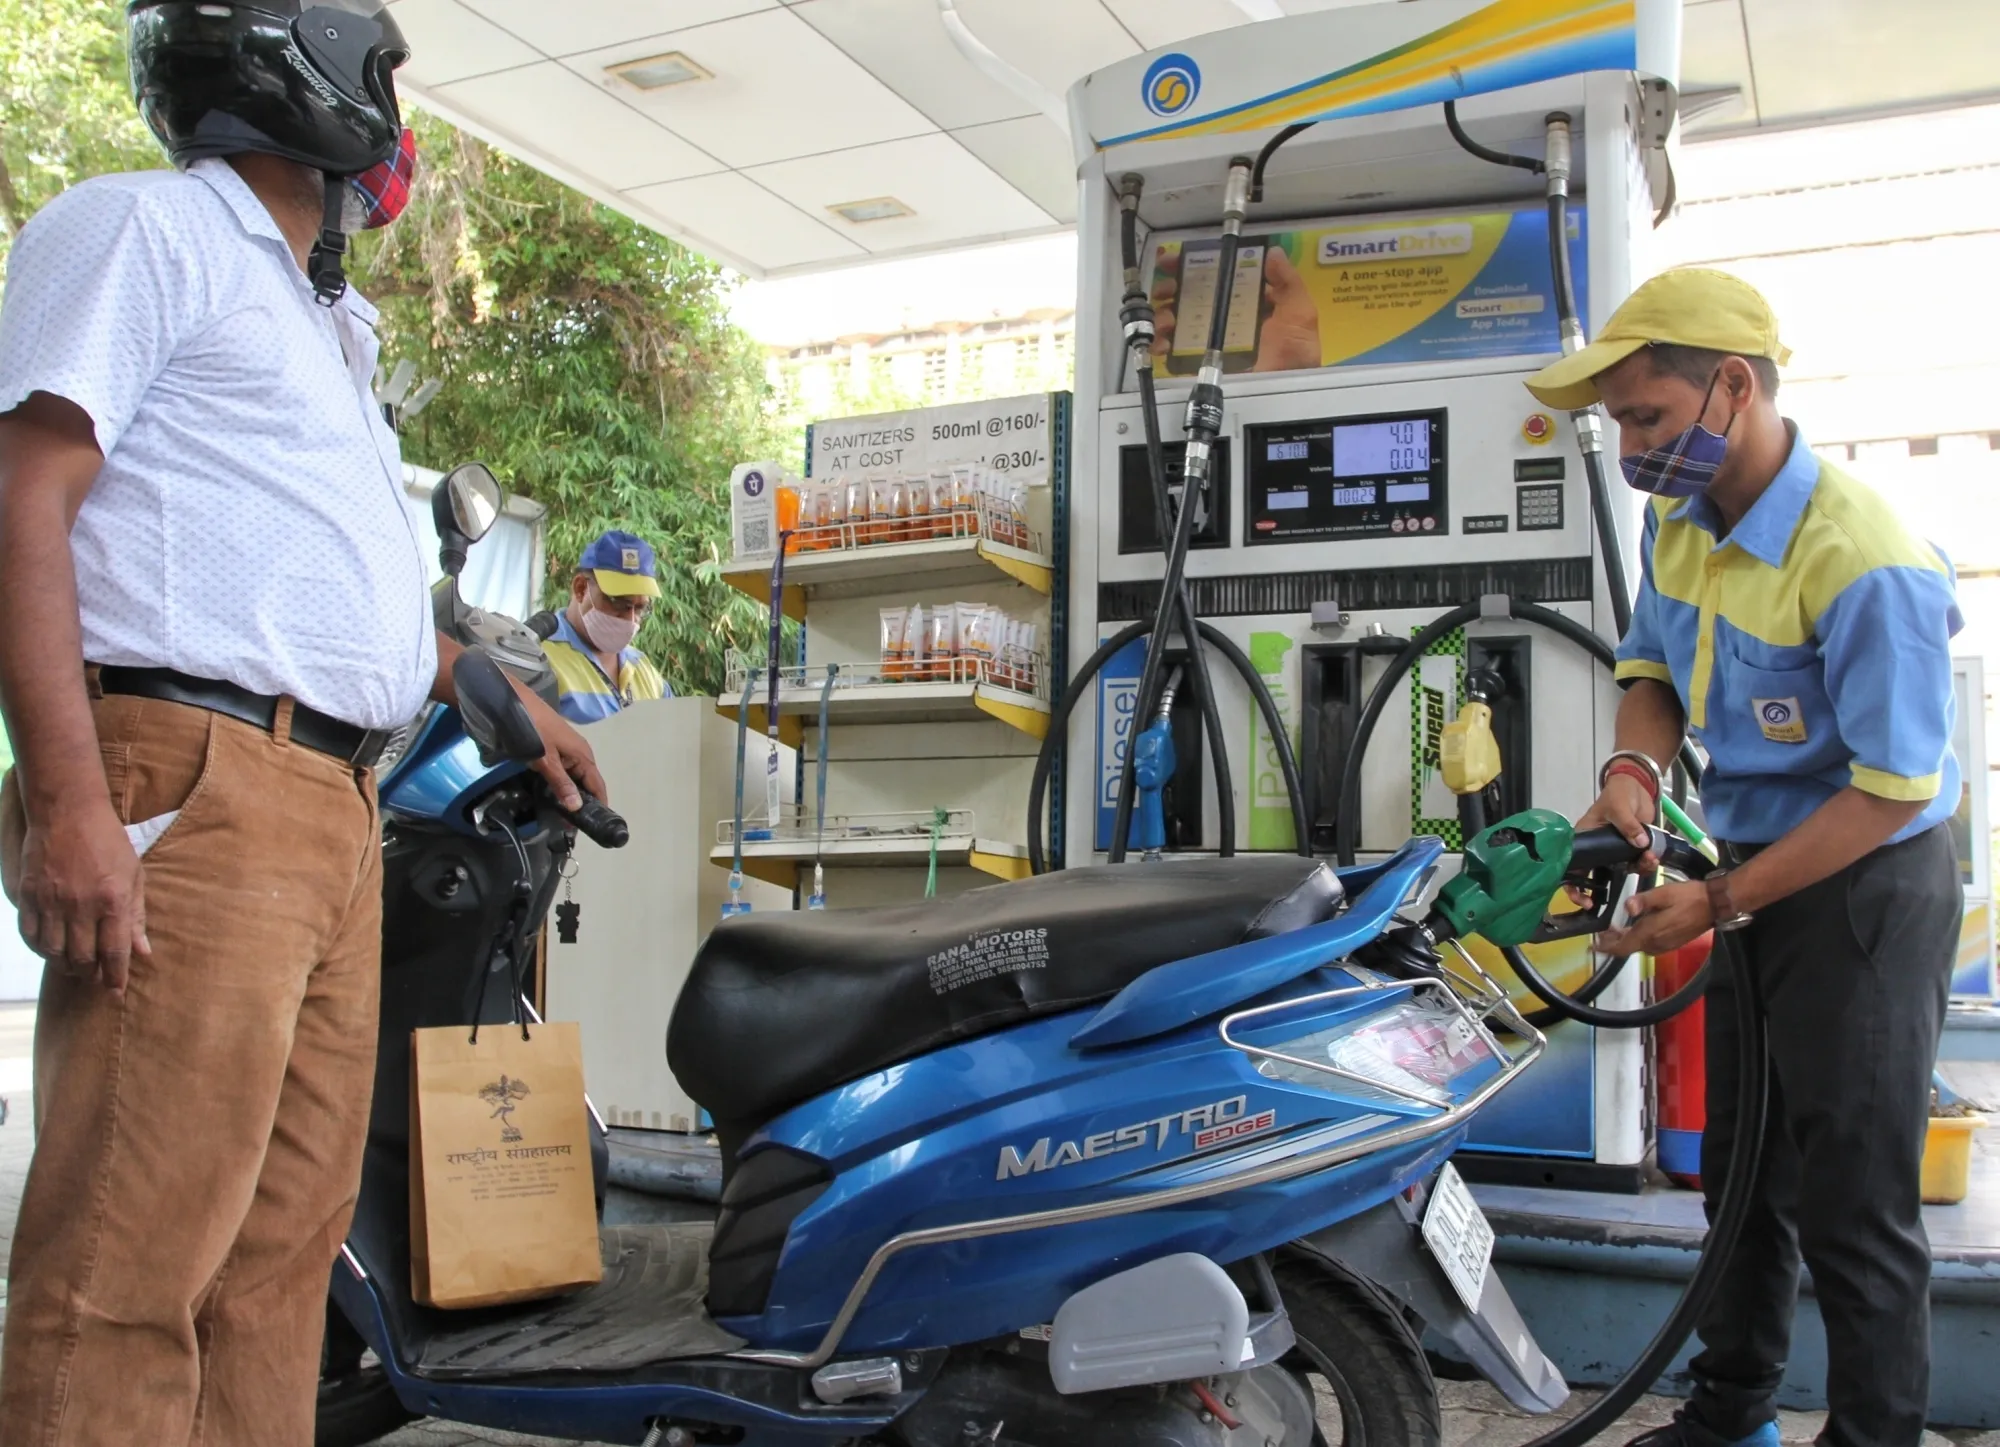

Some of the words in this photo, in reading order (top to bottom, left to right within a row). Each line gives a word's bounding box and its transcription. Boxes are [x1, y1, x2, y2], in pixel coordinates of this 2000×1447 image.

[280, 45, 340, 108] Running
[1340, 271, 1349, 281] A
[1353, 267, 1414, 281] one-stop
[1418, 265, 1443, 277] app
[1471, 320, 1493, 330] App
[932, 422, 980, 441] 500ml
[986, 412, 1045, 437] @160/-
[822, 427, 915, 452] SANITIZERS
[831, 456, 851, 471] AT
[859, 449, 904, 467] COST
[1390, 447, 1427, 471] 0.04
[927, 943, 970, 968] RANA
[975, 928, 1049, 949] MOTORS
[960, 945, 996, 961] SERVICE
[1027, 944, 1048, 953] AREA
[996, 1094, 1247, 1180] MAESTRO
[1198, 1113, 1273, 1147] EDGE
[446, 1147, 499, 1166] राष्ट्रीय
[506, 1144, 572, 1160] संग्रहालय
